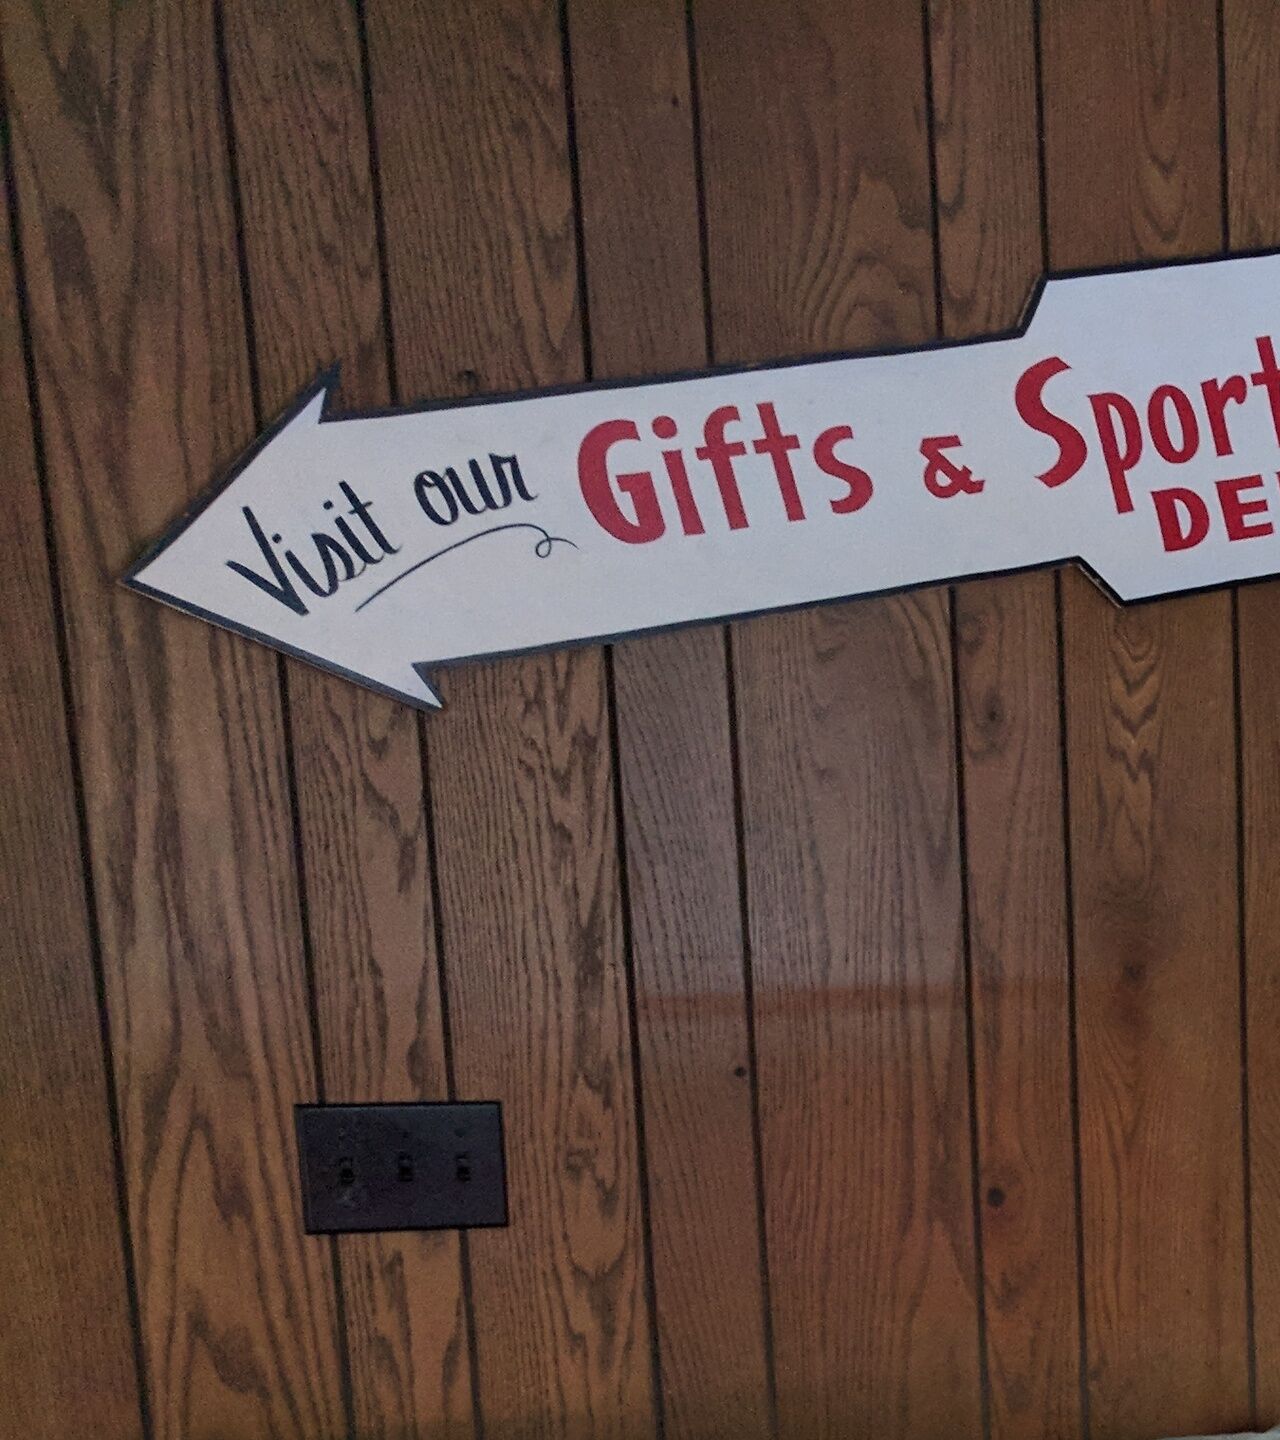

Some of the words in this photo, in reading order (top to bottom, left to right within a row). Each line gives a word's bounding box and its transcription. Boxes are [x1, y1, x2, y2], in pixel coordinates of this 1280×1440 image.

[226, 481, 401, 616] Visit
[413, 450, 539, 527] our
[577, 401, 875, 545] Gifts
[919, 434, 985, 500] &
